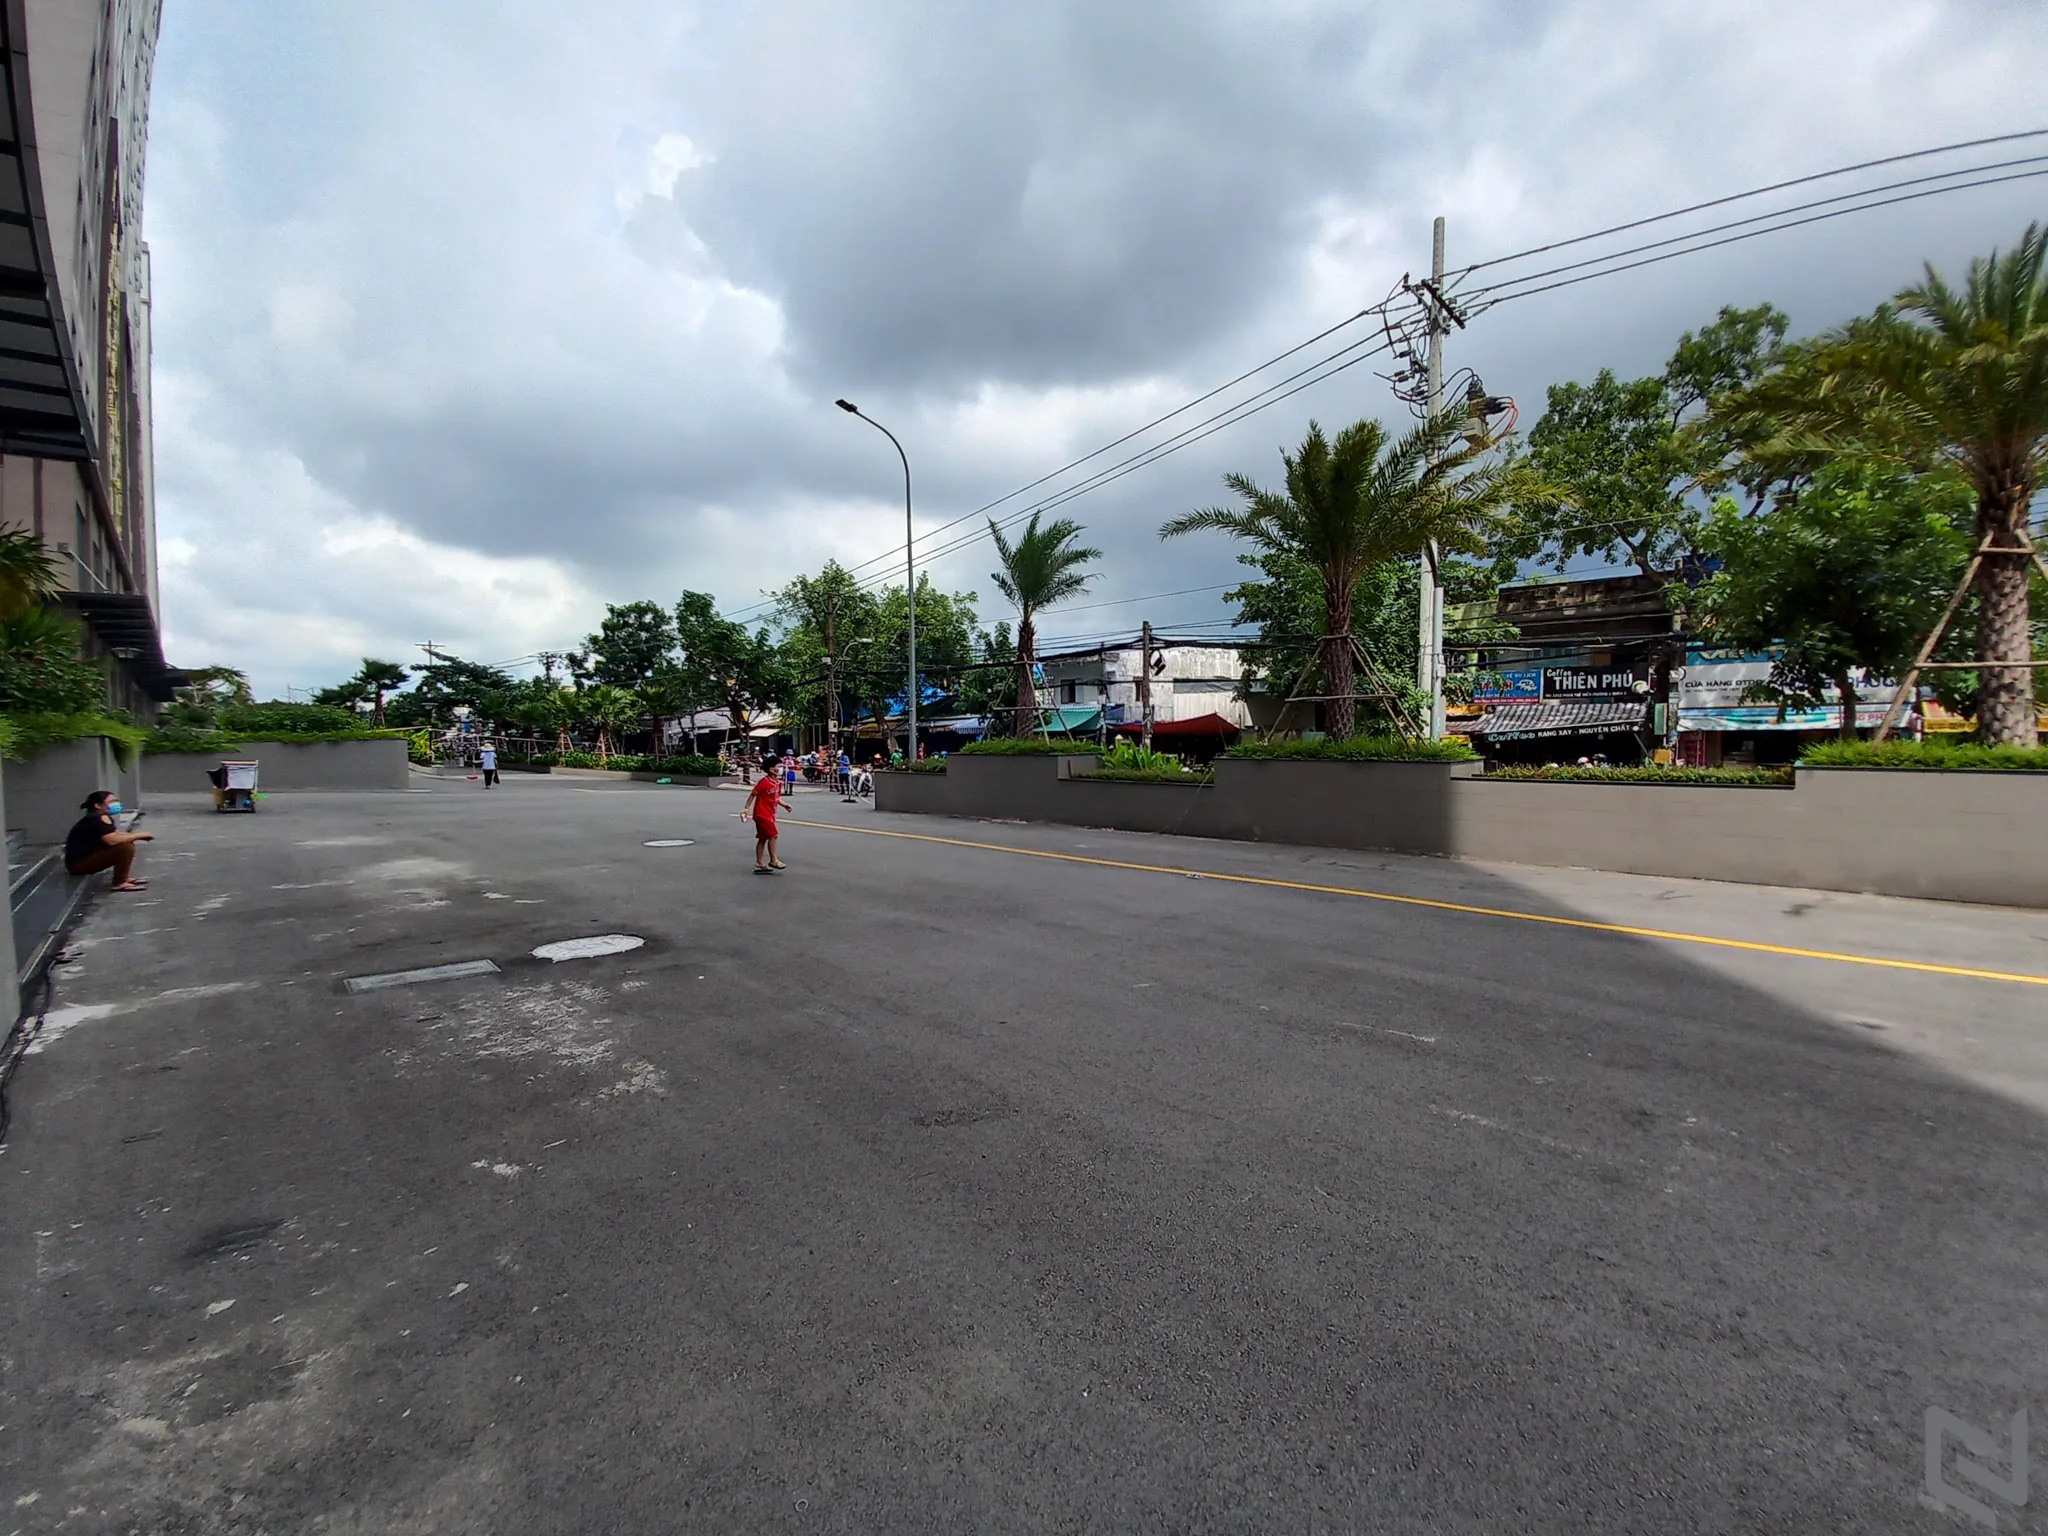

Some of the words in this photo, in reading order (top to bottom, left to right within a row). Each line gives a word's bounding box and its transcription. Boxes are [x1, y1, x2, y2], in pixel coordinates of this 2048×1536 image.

[1547, 669, 1572, 677] Coffee
[1554, 672, 1597, 690] THIÊN
[1602, 670, 1633, 688] PHÚ
[1579, 727, 1609, 735] NGUYÊN
